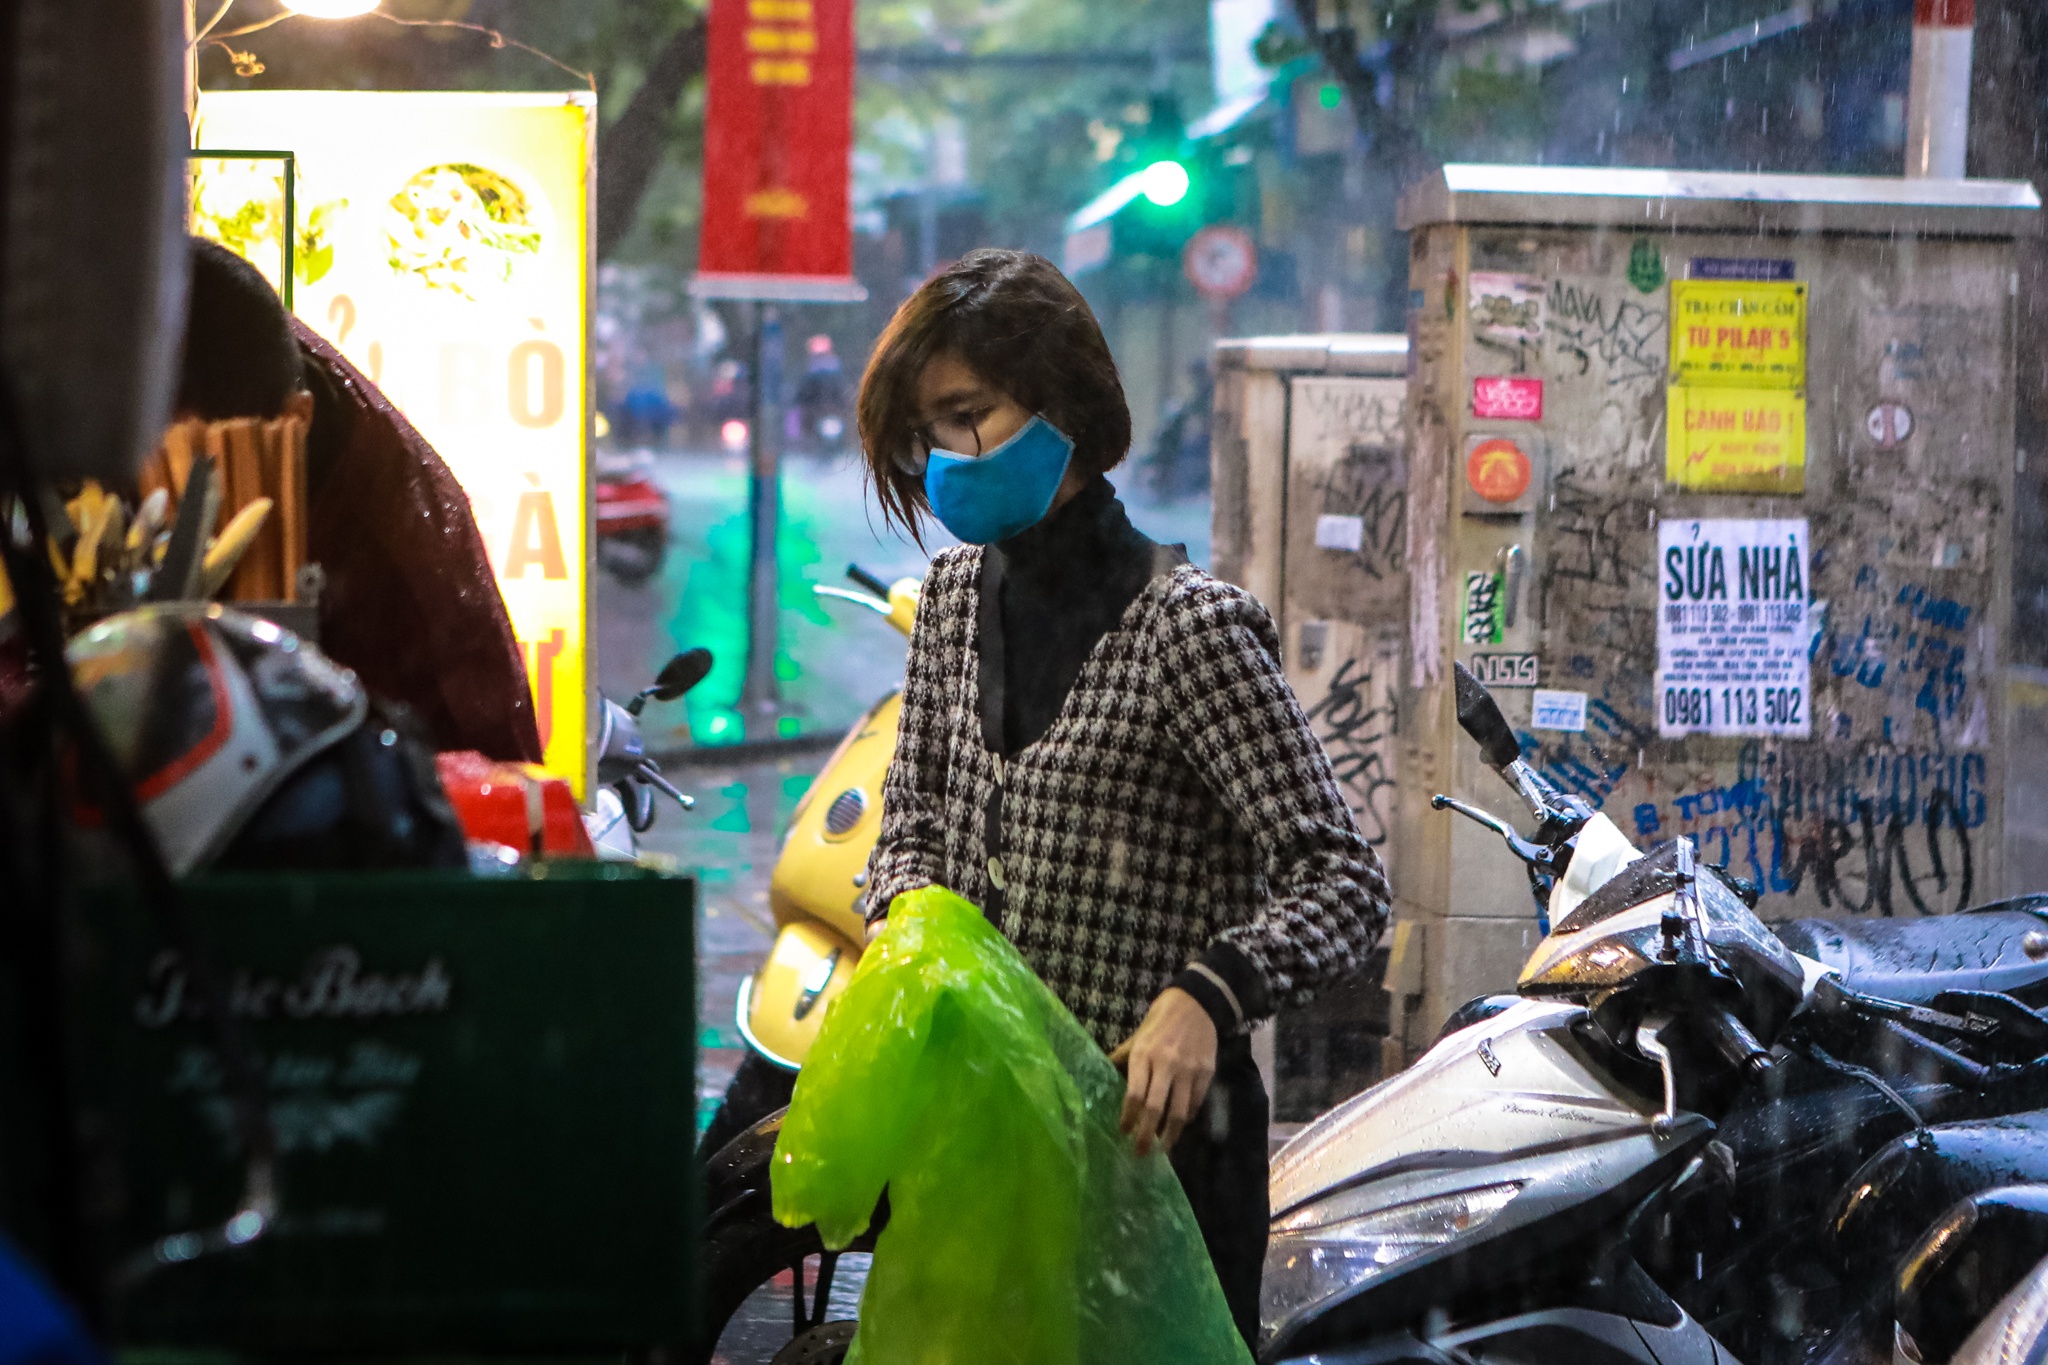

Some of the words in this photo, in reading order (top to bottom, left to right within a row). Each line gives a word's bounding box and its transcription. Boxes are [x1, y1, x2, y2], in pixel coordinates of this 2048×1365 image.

[1665, 522, 1728, 600] SỬA
[1739, 533, 1804, 600] NHÀ
[1665, 687, 1712, 725] 0981
[1722, 687, 1758, 725] 113
[1765, 687, 1802, 725] 502
